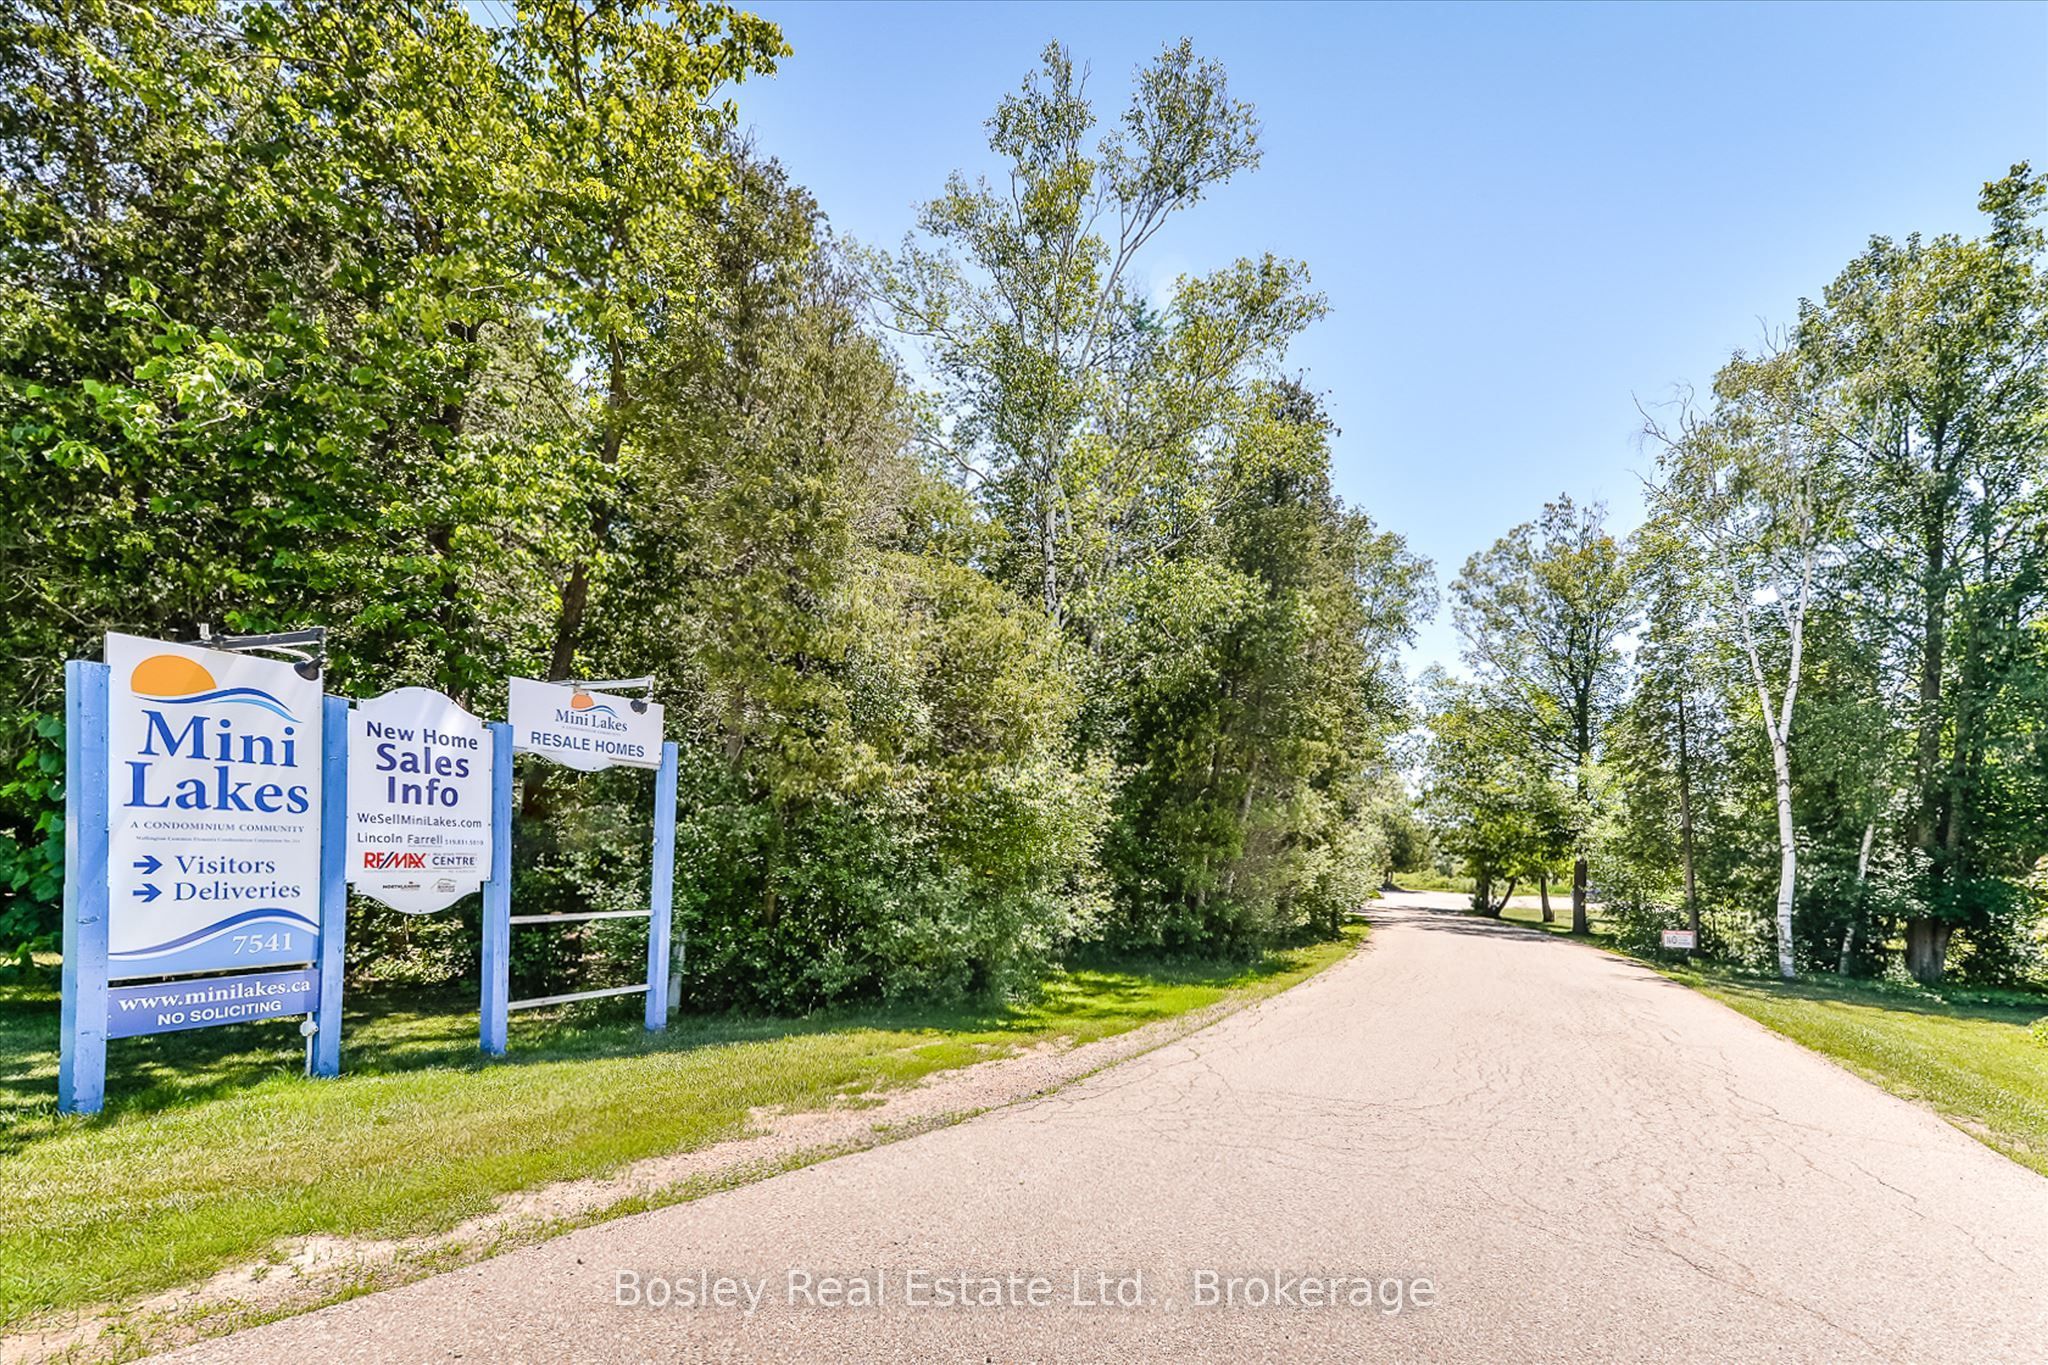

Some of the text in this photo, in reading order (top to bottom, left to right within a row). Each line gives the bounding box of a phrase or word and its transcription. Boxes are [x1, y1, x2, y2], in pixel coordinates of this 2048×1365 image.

[555, 709, 589, 727] Mini
[592, 715, 628, 732] Lakes
[137, 709, 299, 768] Mini
[366, 721, 478, 750] New Home
[531, 731, 591, 751] RESALE
[595, 740, 645, 757] HOMES
[375, 743, 470, 778] Sales
[123, 761, 310, 814] Lakes
[387, 776, 459, 807] Info
[130, 821, 305, 833] A CONDOMINIUM COMMUNITY
[357, 812, 482, 829] WeSellMiniLakes.com
[357, 832, 403, 844] Lincoln
[407, 834, 444, 846] Farrell
[175, 855, 275, 875] Visitors
[363, 851, 476, 870] RE/MAX CENTRE
[174, 881, 301, 901] Deliveries
[232, 932, 292, 956] 7541
[119, 980, 311, 1012] www.minilakes.ca
[157, 1000, 282, 1026] NO SOLICITING
